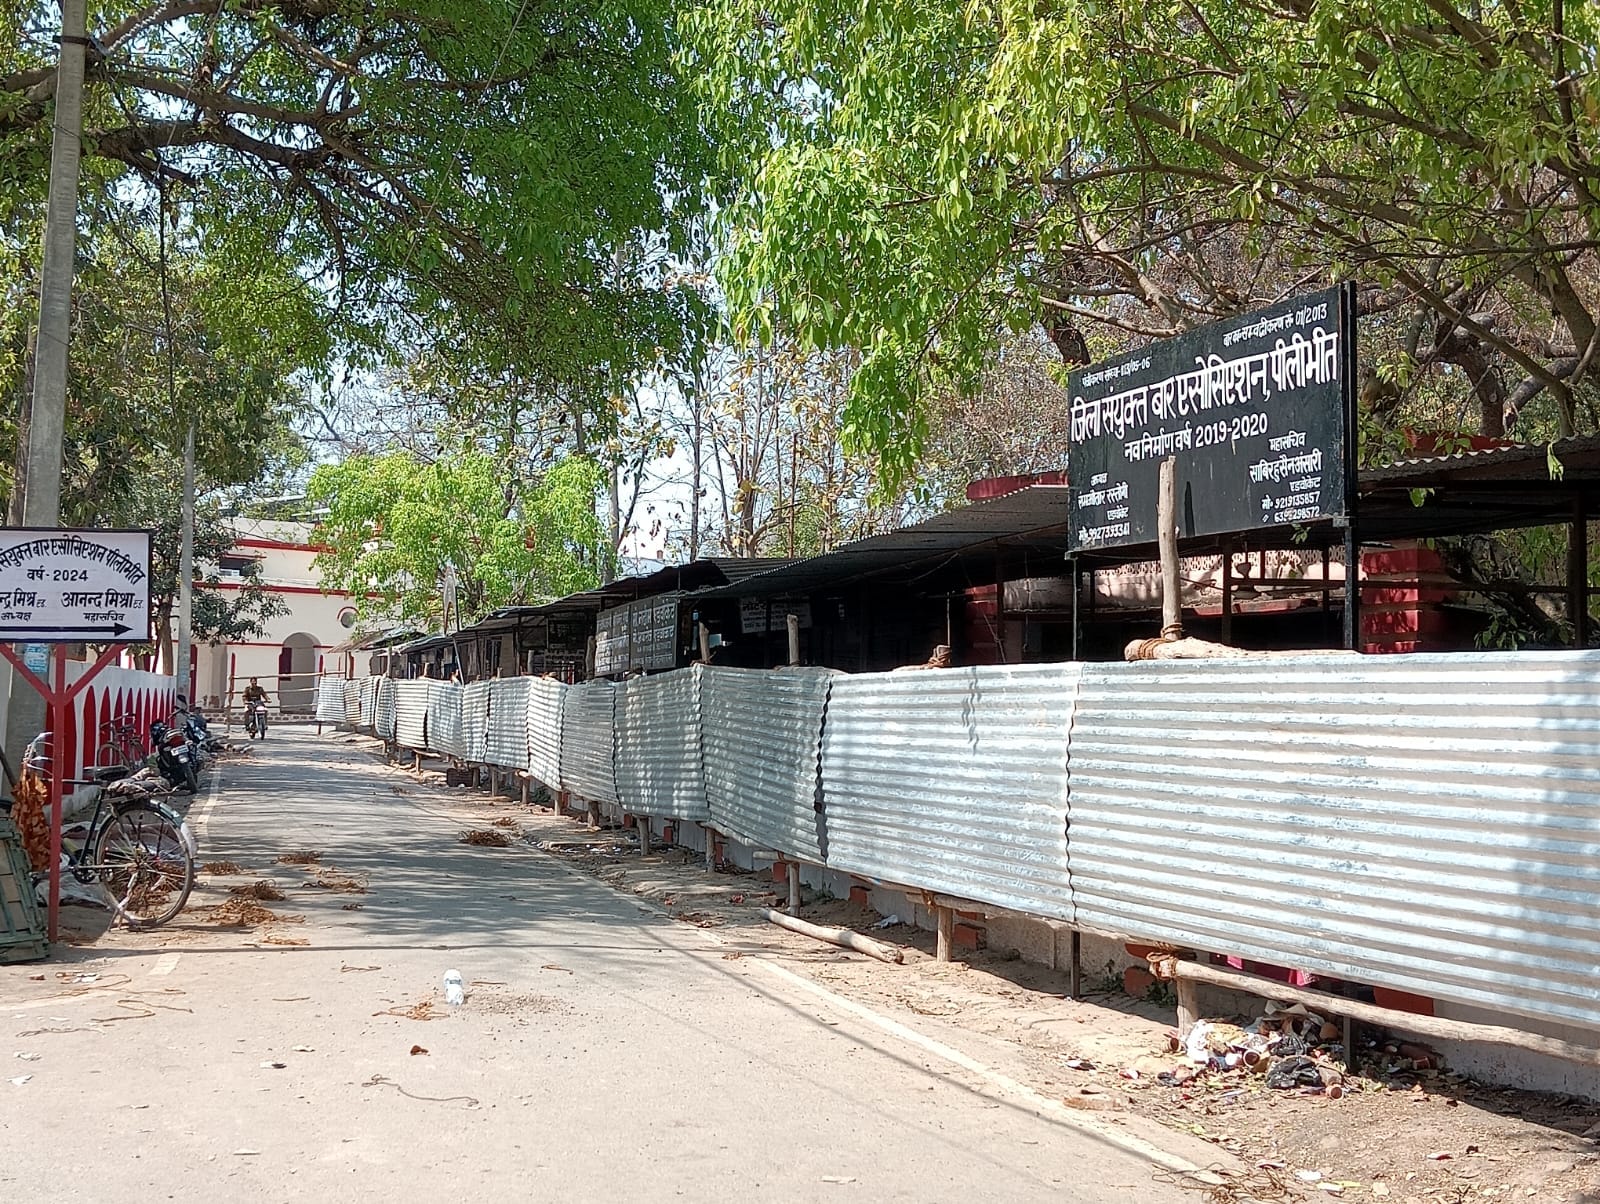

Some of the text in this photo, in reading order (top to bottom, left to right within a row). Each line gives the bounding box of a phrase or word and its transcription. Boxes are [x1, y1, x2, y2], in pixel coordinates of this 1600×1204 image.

[1295, 303, 1328, 329] 01/2013
[1100, 385, 1149, 440] संयुक्त
[1148, 376, 1177, 420] बार
[1269, 326, 1339, 392] पीलीभीत
[1195, 412, 1268, 448] 2019-2020
[1268, 430, 1306, 452] महासचिव
[1289, 475, 1322, 492] एडवोकेट
[31, 539, 50, 557] बार
[53, 569, 89, 582] 2024
[61, 591, 104, 608] आनन्द
[104, 588, 135, 608] मिश्रा
[83, 610, 126, 624] महासचिव
